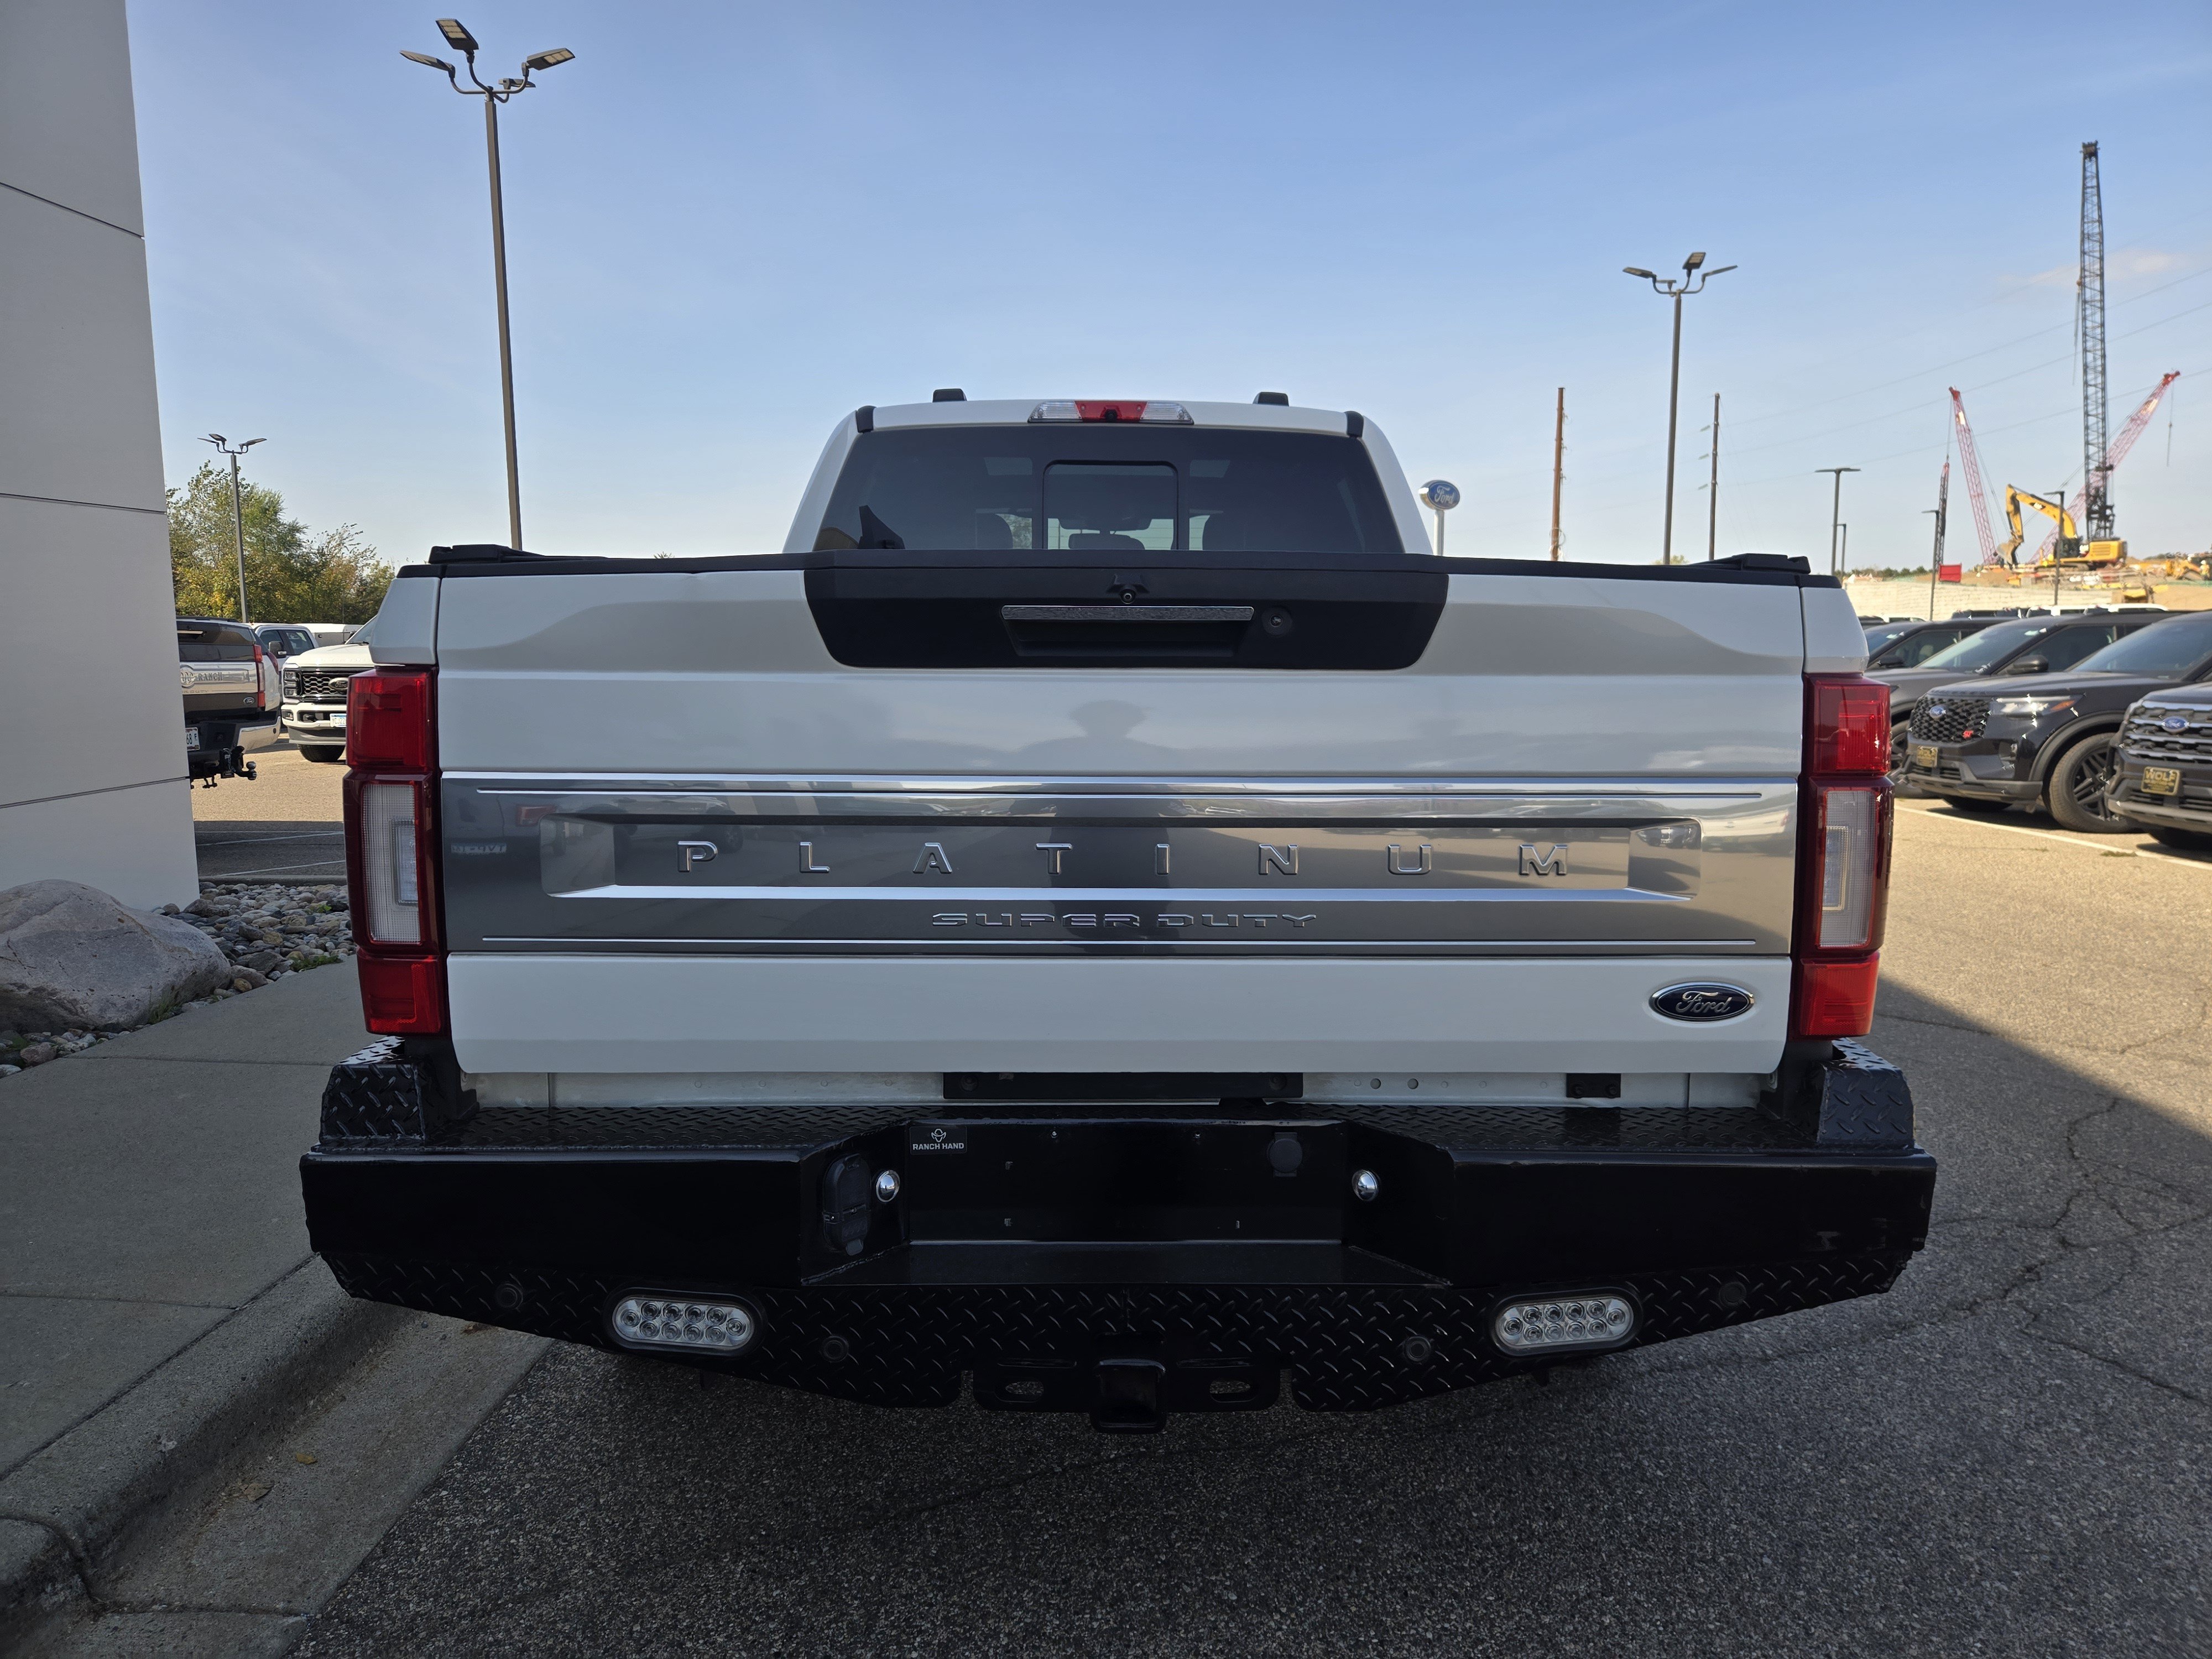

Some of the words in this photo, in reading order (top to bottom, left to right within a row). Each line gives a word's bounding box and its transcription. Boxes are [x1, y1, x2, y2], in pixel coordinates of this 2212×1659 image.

[1434, 486, 1455, 504] Ford
[197, 672, 223, 681] RANCH
[2146, 769, 2176, 782] WOLF
[677, 840, 1568, 876] PLATINUM
[932, 913, 1140, 927] SUPER
[1157, 914, 1316, 928] DUTY
[1675, 990, 1733, 1014] Ford
